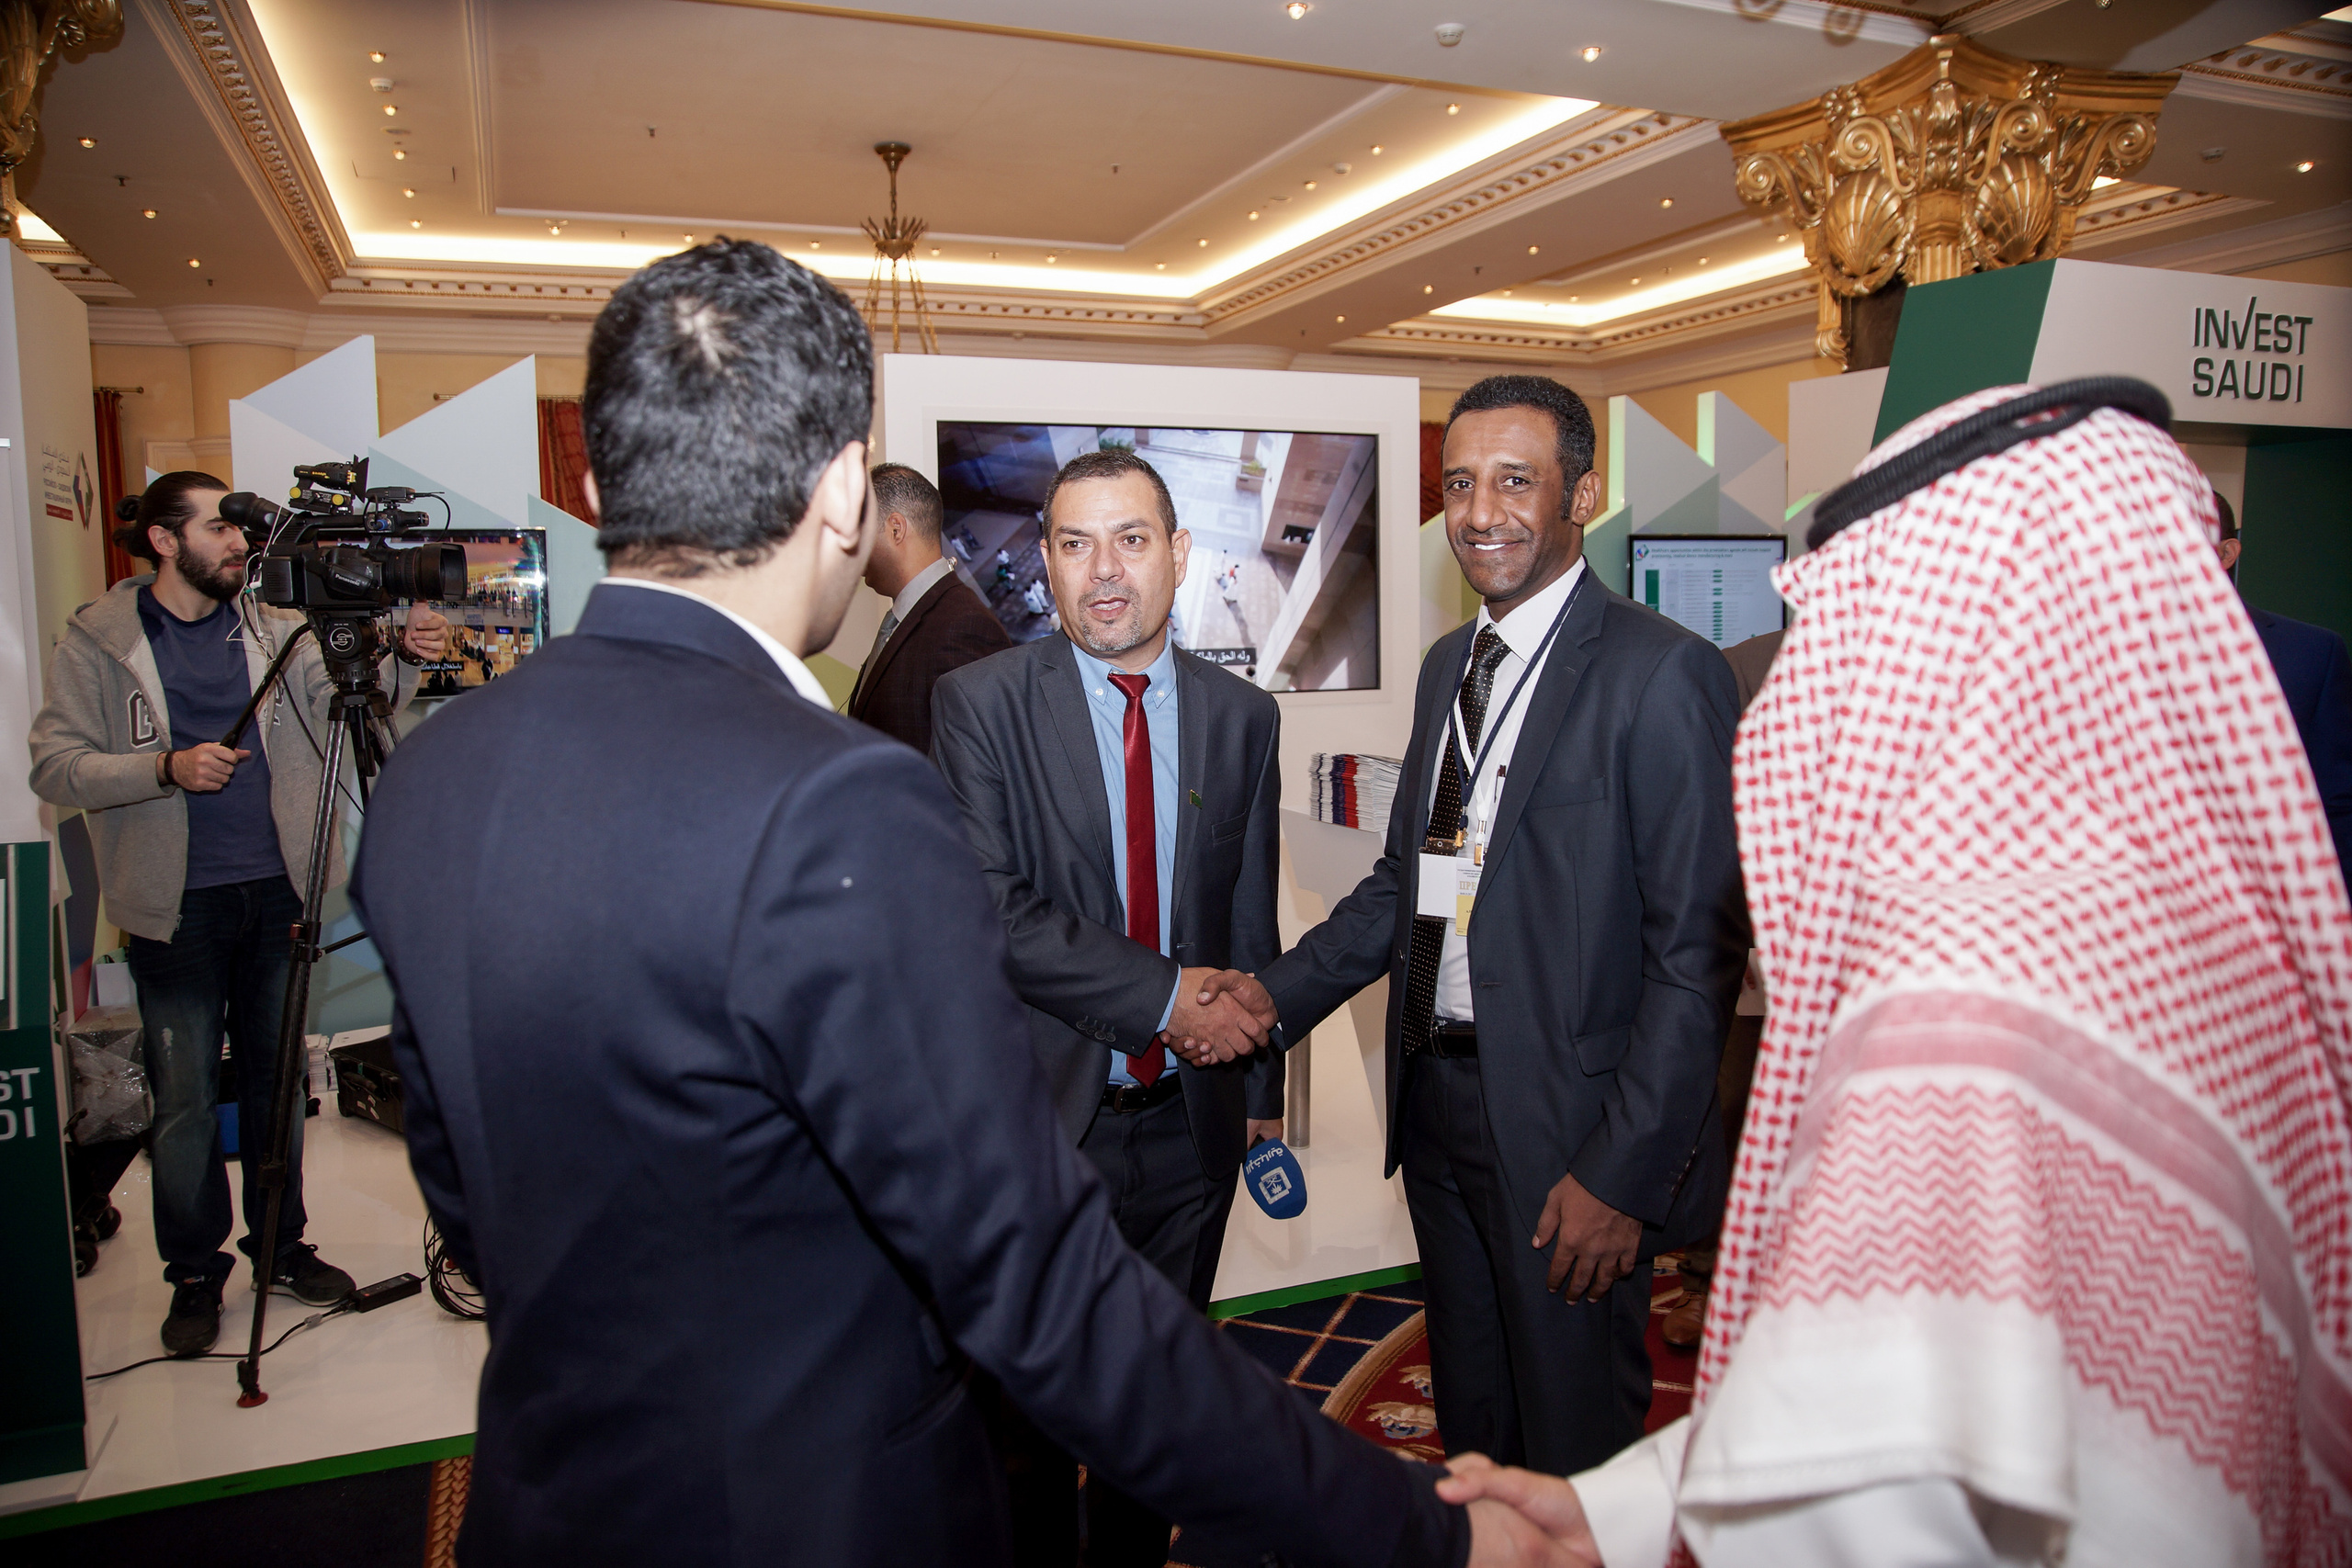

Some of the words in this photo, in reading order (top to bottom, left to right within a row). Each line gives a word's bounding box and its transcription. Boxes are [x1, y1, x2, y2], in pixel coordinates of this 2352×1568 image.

[2193, 297, 2313, 355] INVEST
[2192, 356, 2304, 403] SAUDI
[335, 573, 360, 587] Panasonic
[1217, 650, 1237, 663] الحق
[1237, 649, 1250, 663] وله
[1460, 881, 1476, 891] ПРЕ
